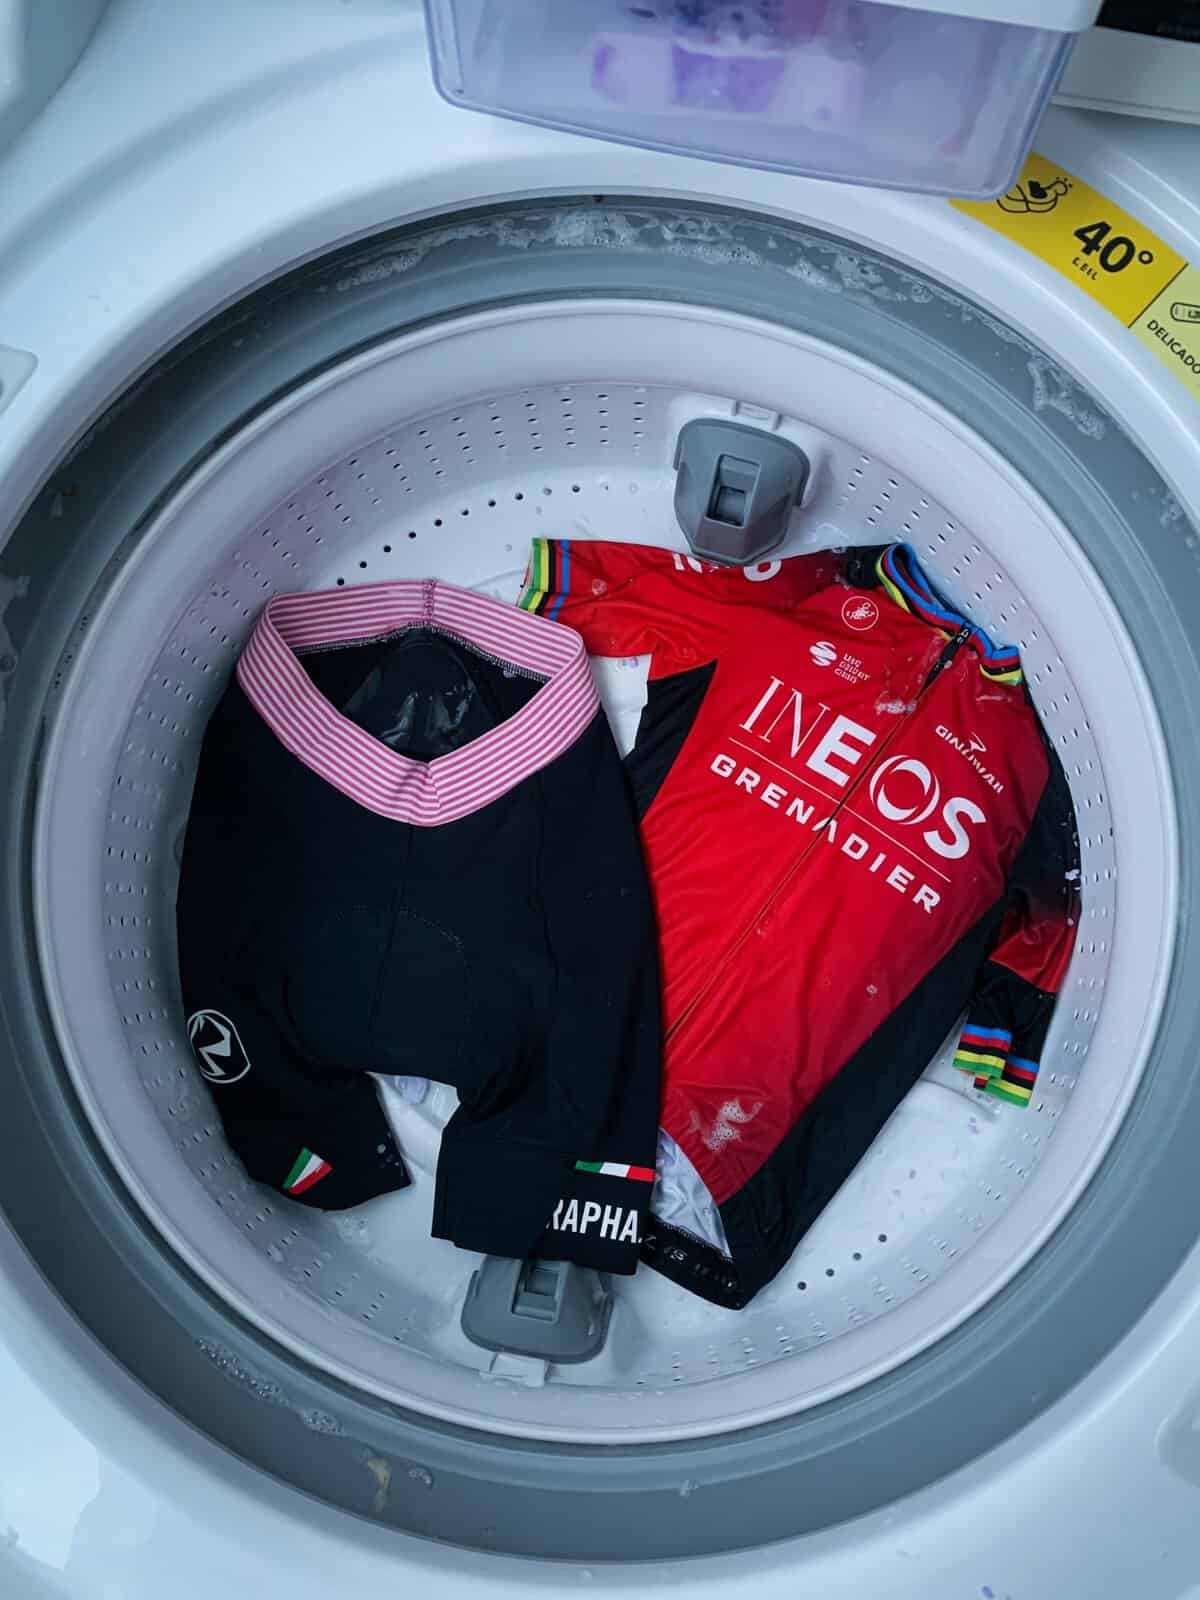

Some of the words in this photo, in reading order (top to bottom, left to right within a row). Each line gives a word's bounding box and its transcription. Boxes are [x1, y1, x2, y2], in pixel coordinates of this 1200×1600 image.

[1073, 221, 1153, 273] 40°
[710, 754, 941, 913] GRENADIER
[739, 676, 986, 860] INEOS
